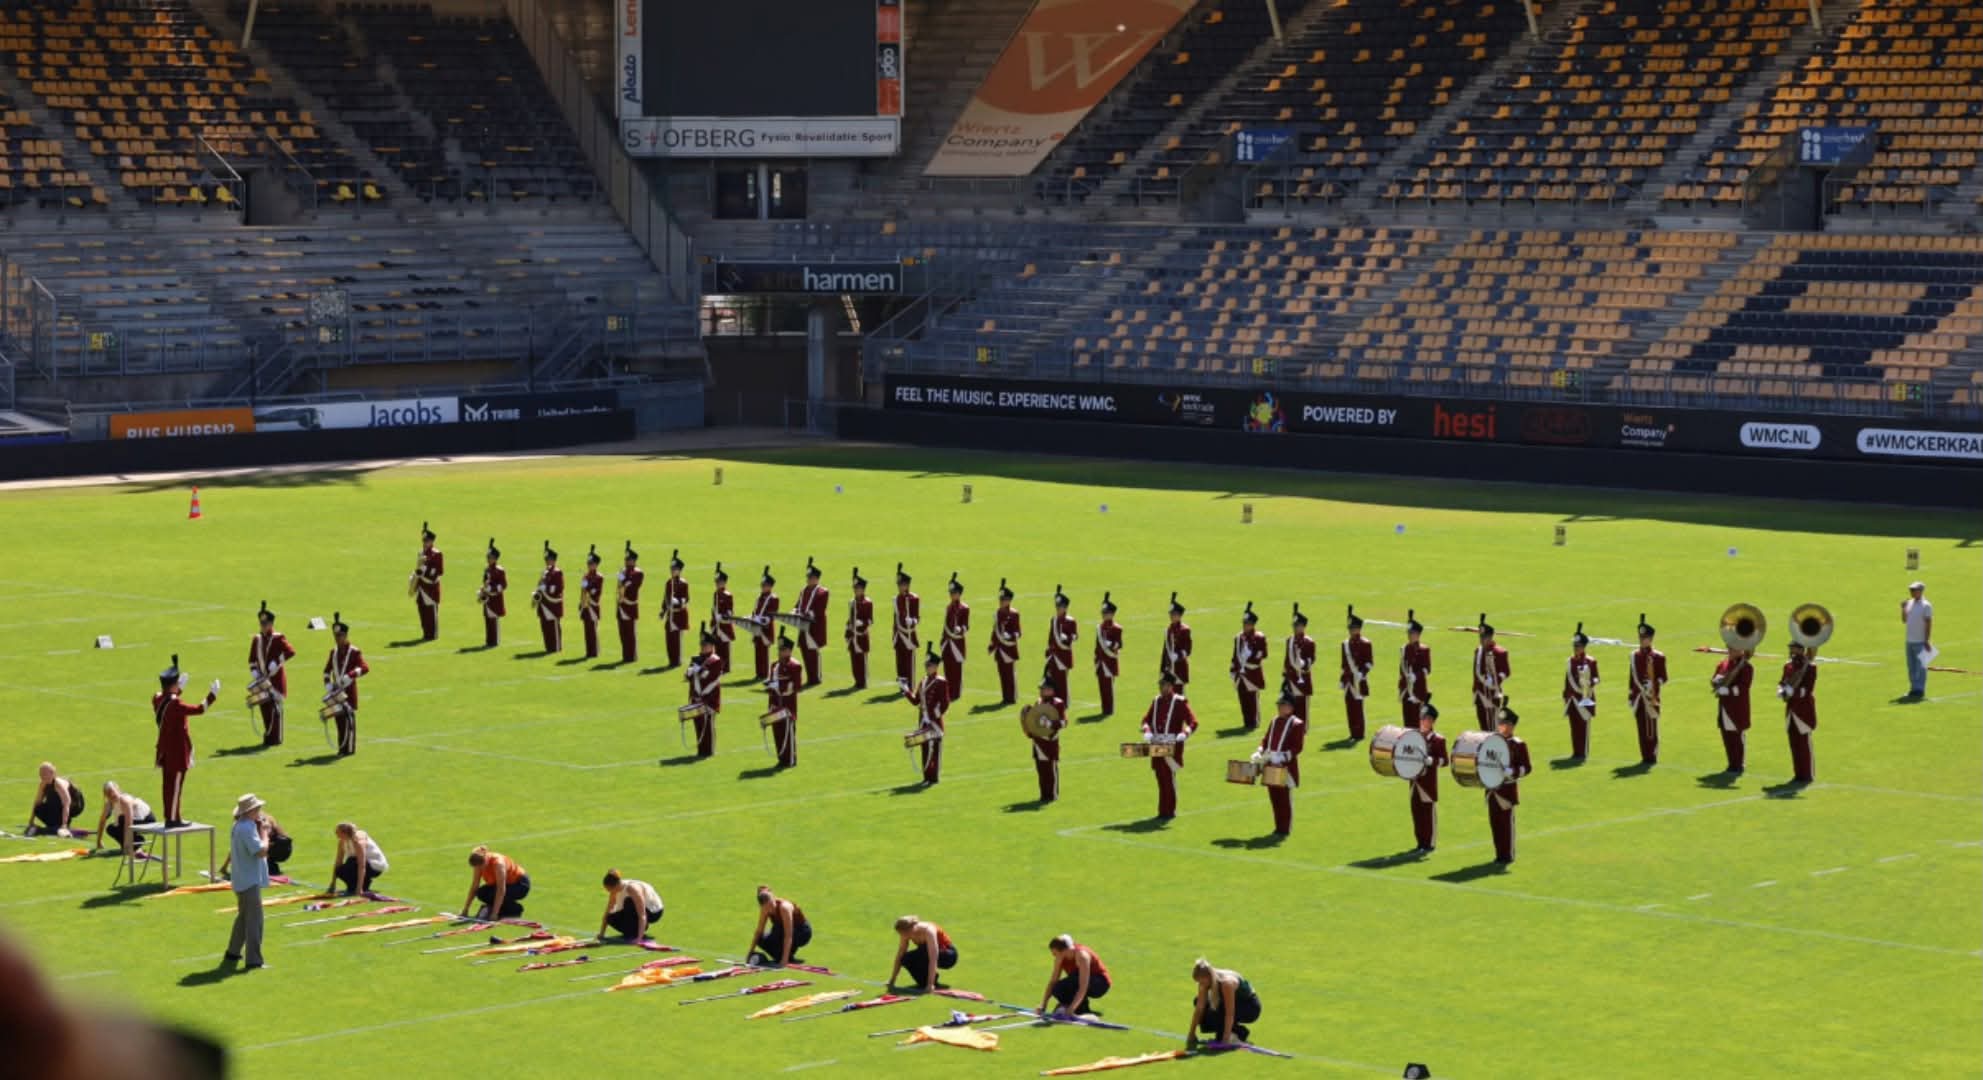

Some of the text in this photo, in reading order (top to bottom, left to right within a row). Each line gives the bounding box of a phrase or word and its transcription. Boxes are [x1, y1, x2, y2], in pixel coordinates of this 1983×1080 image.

[1021, 31, 1167, 92] W
[862, 132, 892, 143] Sport
[947, 135, 1046, 148] Company
[896, 387, 923, 402] FEEL
[927, 388, 949, 404] THE
[999, 392, 1076, 409] EXPERIENCE
[369, 400, 442, 426] Jacobs
[1303, 405, 1398, 425] POWERED BY
[1432, 401, 1497, 440] hesi
[1621, 425, 1667, 440] Company
[1749, 427, 1811, 445] WMC.NL
